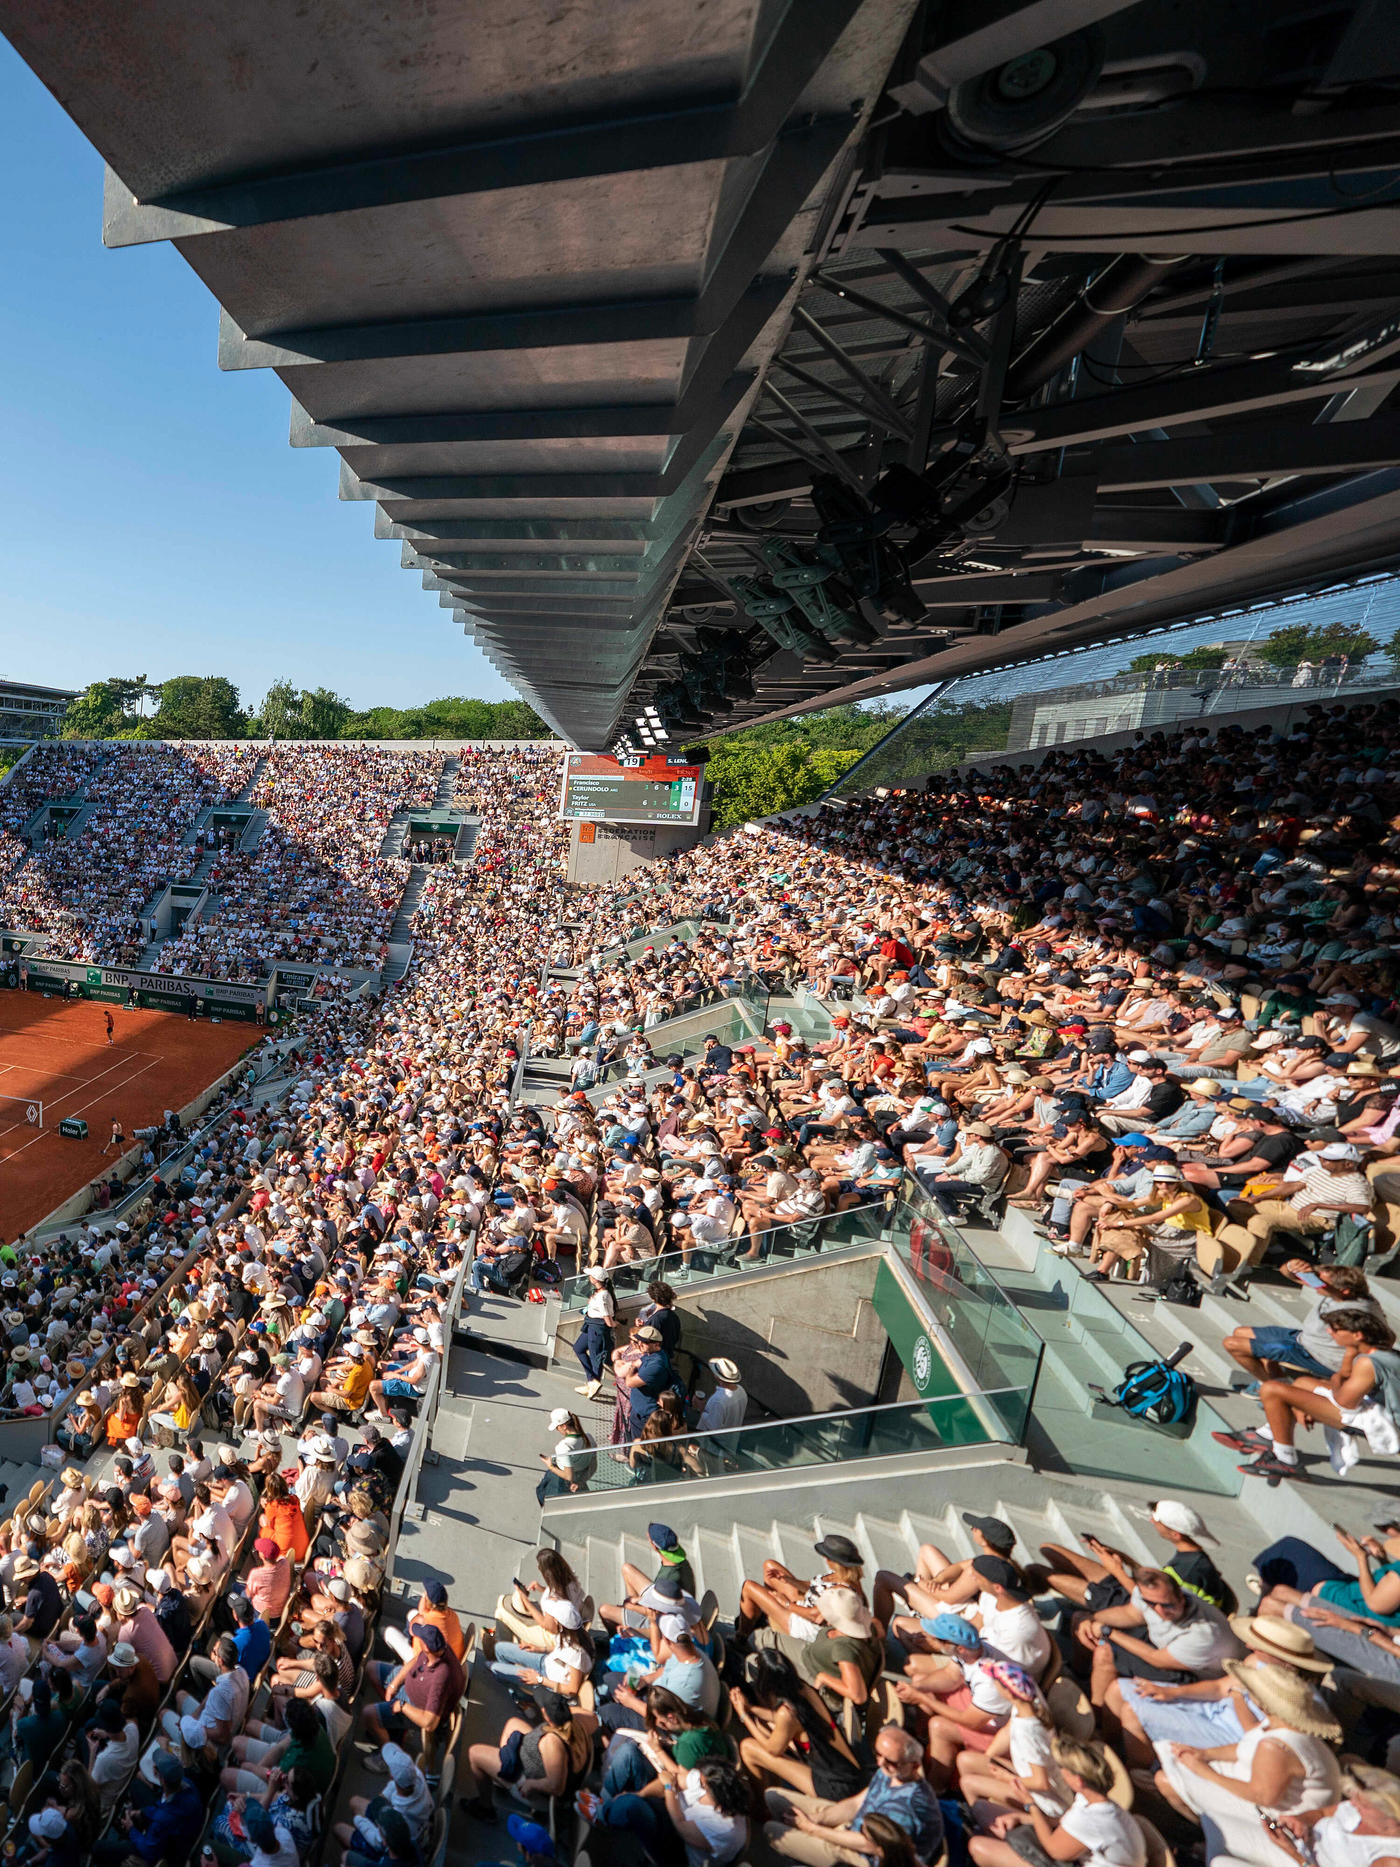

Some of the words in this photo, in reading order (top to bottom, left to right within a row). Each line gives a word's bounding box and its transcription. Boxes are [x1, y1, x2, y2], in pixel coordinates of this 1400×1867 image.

[627, 758, 638, 766] 19
[50, 966, 71, 974] PARIBAS
[282, 972, 310, 982] Emirates
[105, 973, 128, 985] BNP
[140, 977, 190, 994] PARIBAS
[101, 990, 121, 998] PARIBAS
[230, 989, 254, 998] PARIBAS
[160, 998, 182, 1007] PARIBAS
[223, 1007, 246, 1016] PARIBAS
[62, 1126, 79, 1135] Haier
